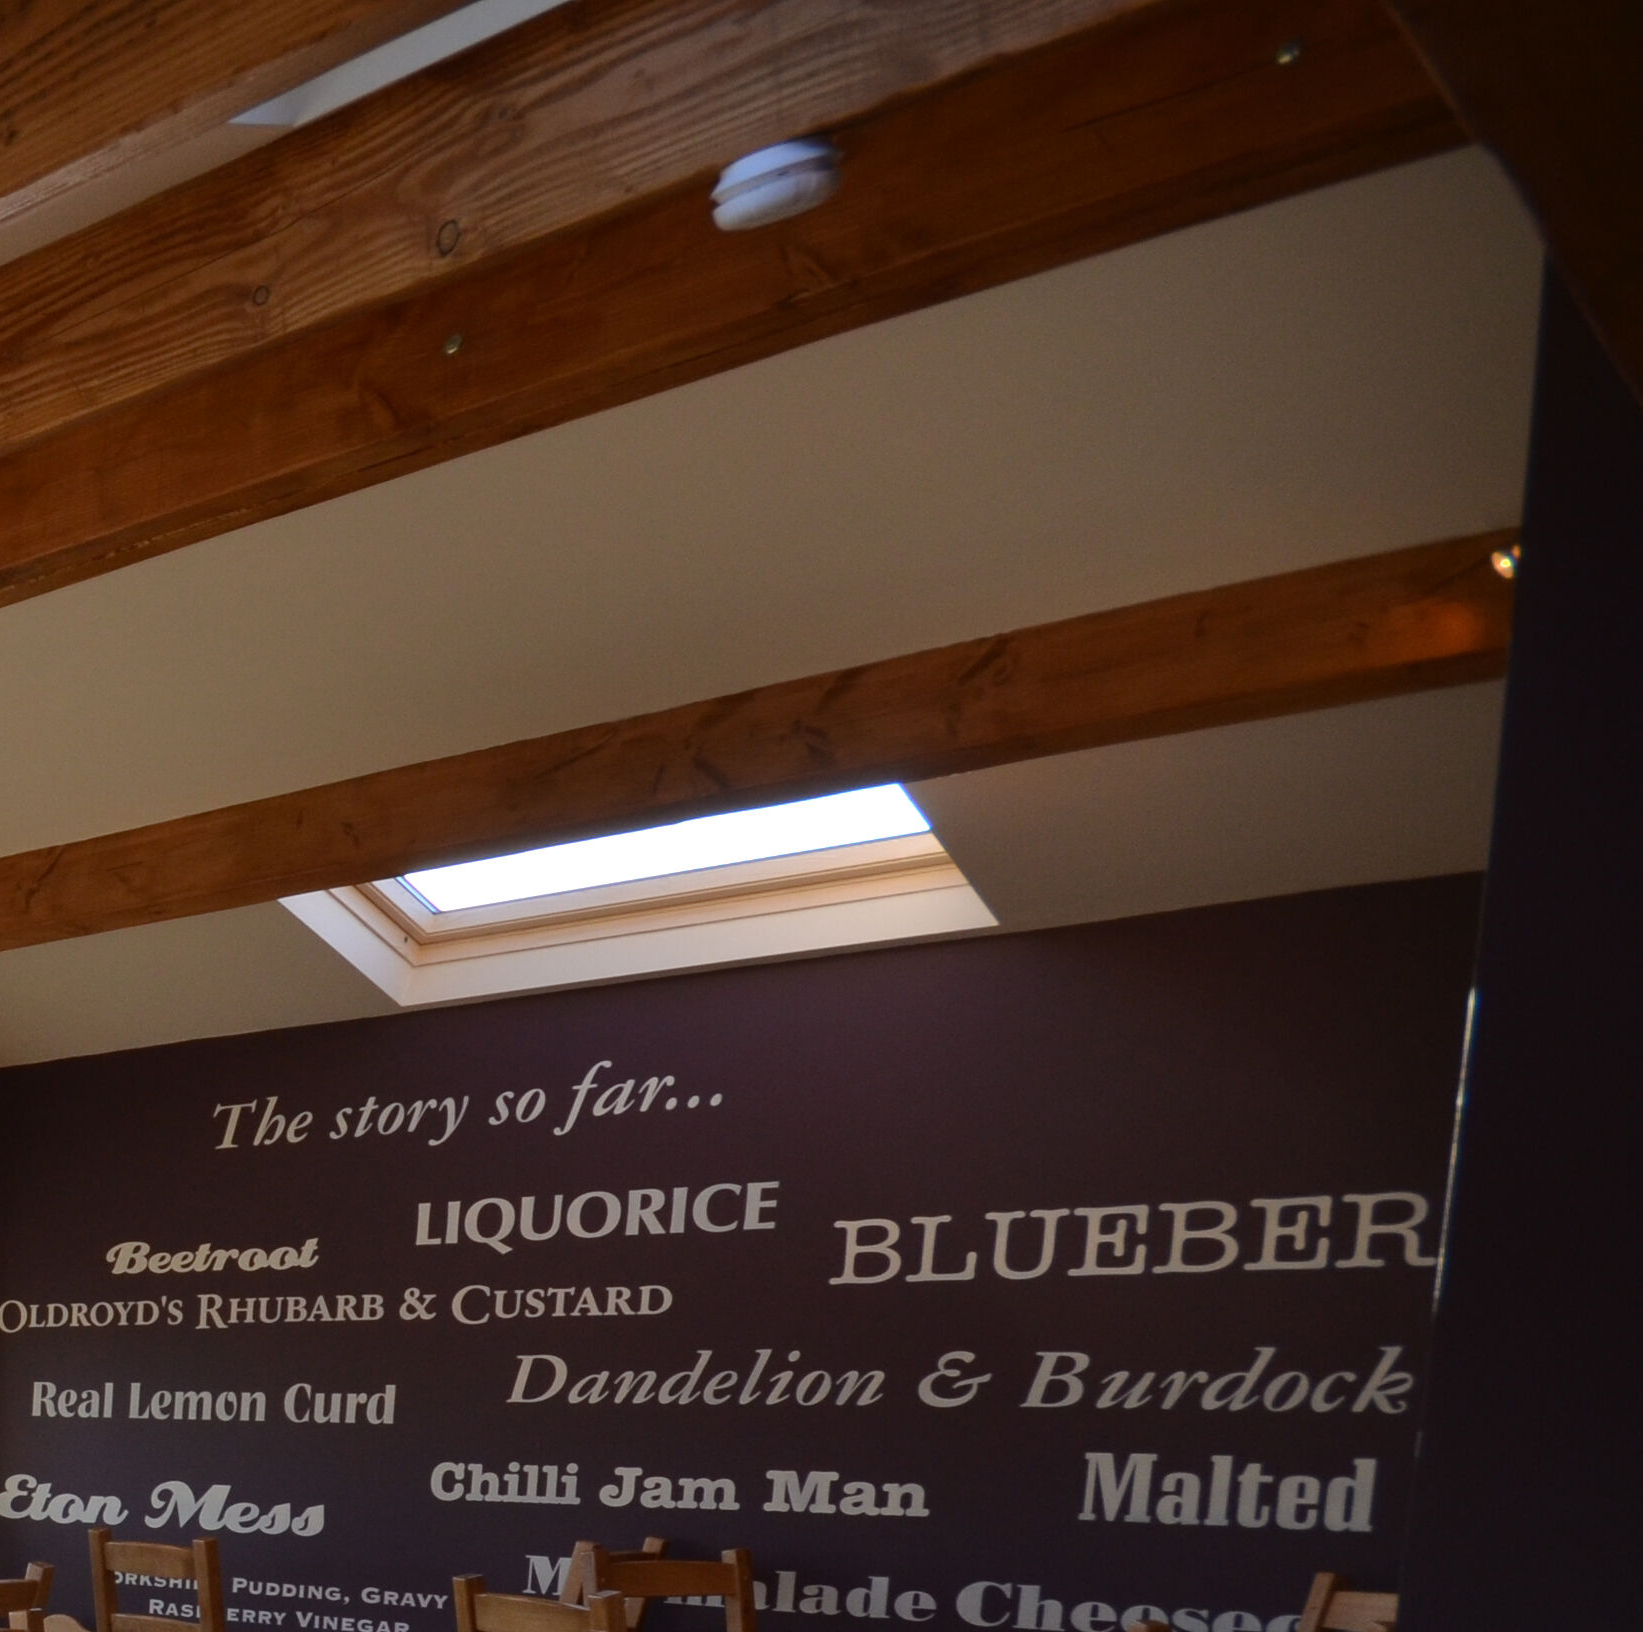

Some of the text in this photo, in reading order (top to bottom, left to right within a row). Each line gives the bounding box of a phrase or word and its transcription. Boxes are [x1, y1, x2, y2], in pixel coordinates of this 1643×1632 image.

[214, 1060, 722, 1150] The story so far...
[416, 1181, 780, 1254] LIQUORICE
[829, 1192, 1436, 1285] BLUEBER
[106, 1238, 319, 1275] Beetroot
[196, 1294, 384, 1329] RHUBARB
[399, 1287, 436, 1321] &
[452, 1285, 673, 1325] CUSTARD
[32, 1382, 396, 1425] Real Lemon Curd
[507, 1346, 1414, 1415] Dandelion & Burdock
[145, 1481, 325, 1537] Mess
[430, 1462, 930, 1517] Chilli Jam Man
[1079, 1452, 1377, 1533] Malted
[148, 1599, 286, 1626] RASERRY
[232, 1577, 350, 1604] PUDDING,
[361, 1587, 448, 1610] GRAVY
